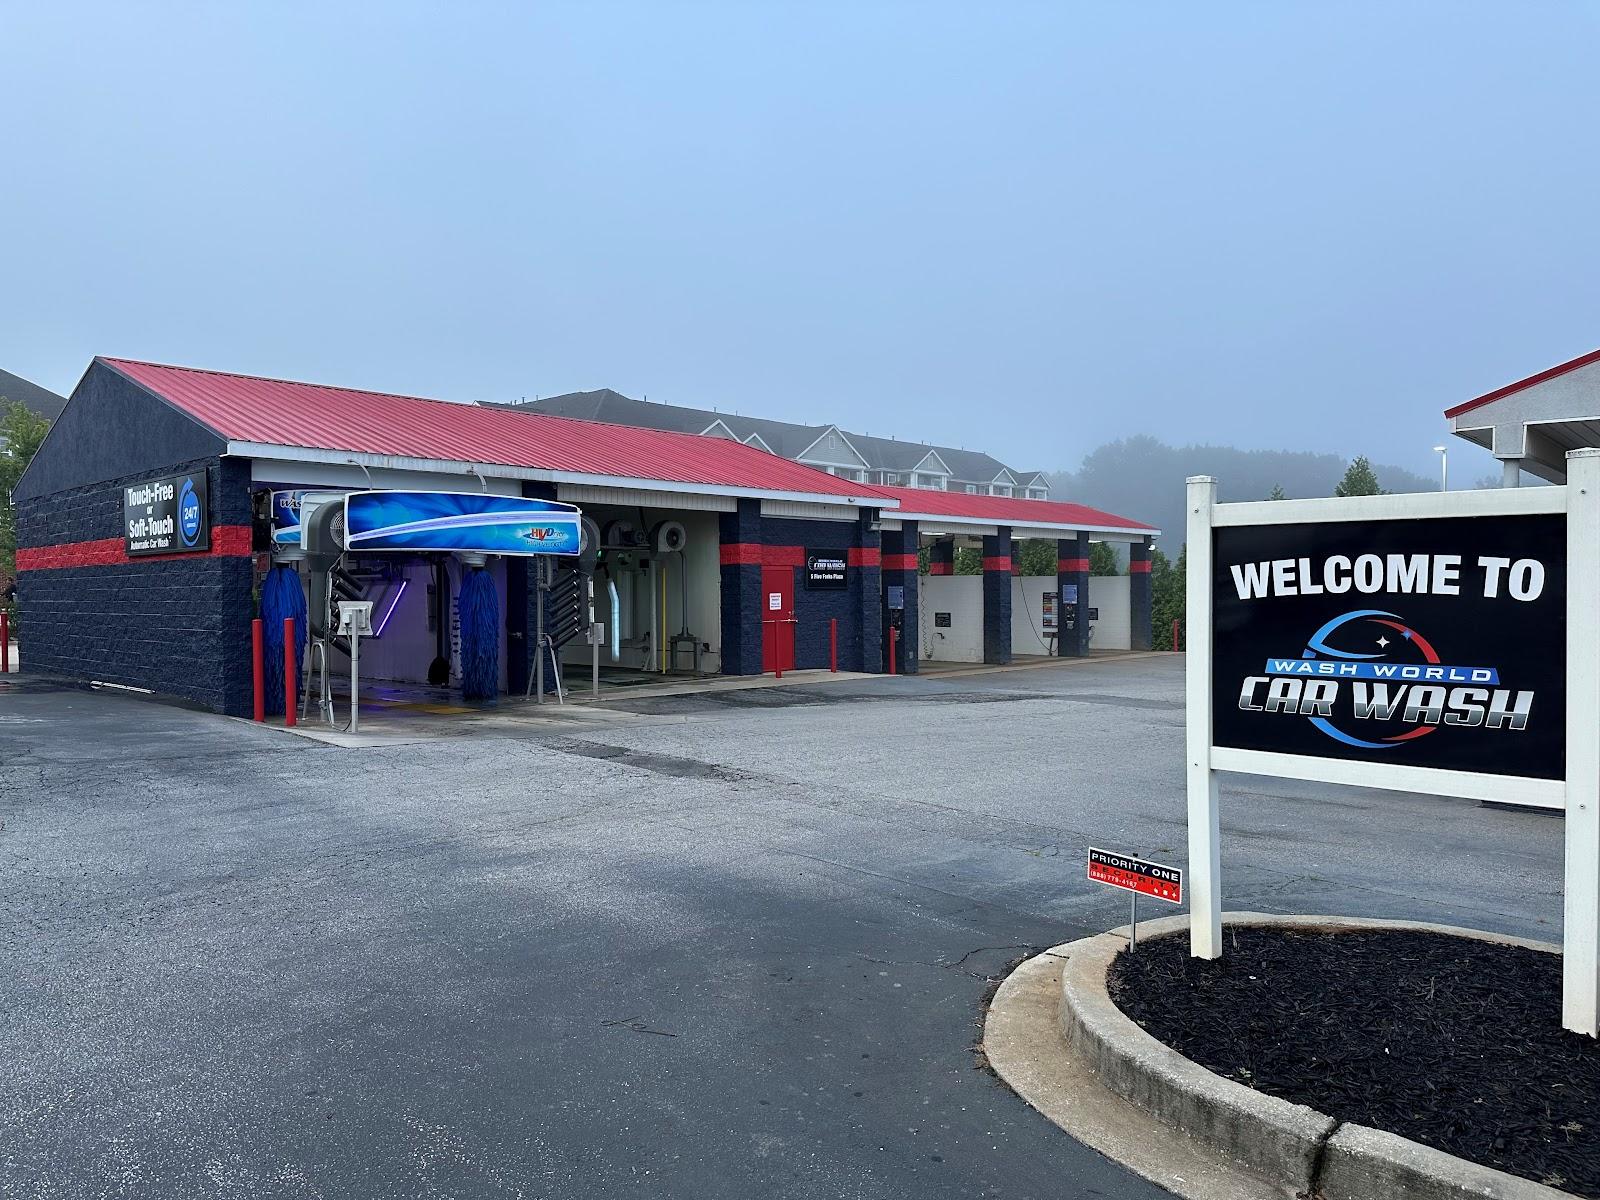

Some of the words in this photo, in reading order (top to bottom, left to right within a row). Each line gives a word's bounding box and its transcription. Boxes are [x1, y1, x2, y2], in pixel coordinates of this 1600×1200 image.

[128, 483, 173, 506] Touch-Free
[146, 506, 154, 515] or
[184, 507, 197, 520] 24/7
[129, 514, 173, 538] Soft-Touch
[1230, 554, 1461, 600] WELCOME
[1478, 556, 1545, 601] TO
[1274, 660, 1358, 676] WASH
[1373, 665, 1492, 682] WORLD
[1238, 676, 1339, 717] CAR
[1352, 680, 1534, 730] WASH
[1090, 863, 1178, 891] SECURITY
[1091, 853, 1147, 873] PRIORITY
[1152, 868, 1179, 882] ONE
